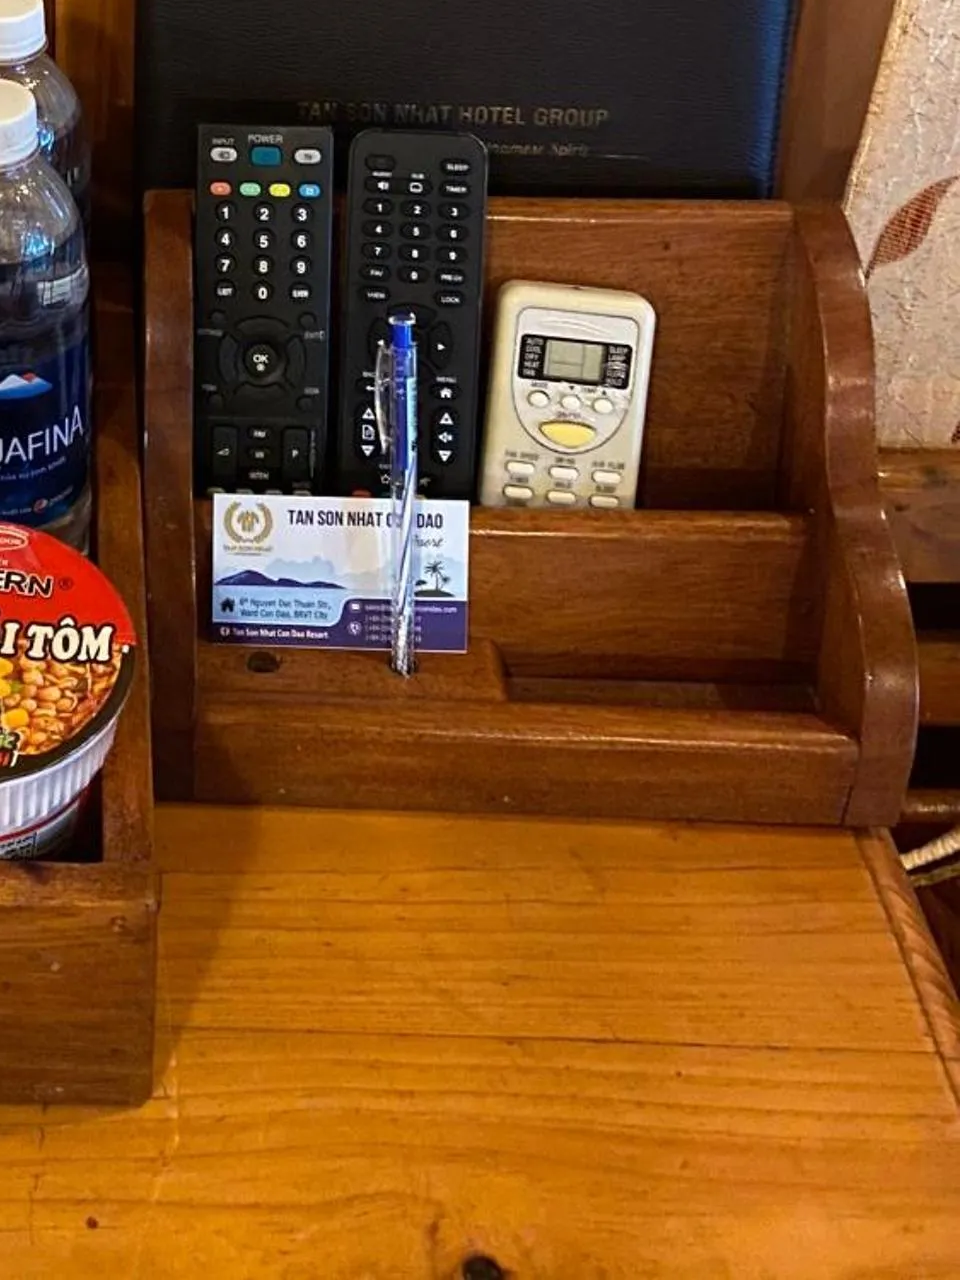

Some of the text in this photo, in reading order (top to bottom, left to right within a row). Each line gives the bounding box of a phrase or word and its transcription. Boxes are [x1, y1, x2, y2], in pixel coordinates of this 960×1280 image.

[394, 103, 453, 125] NHAT
[459, 106, 526, 125] HOTEL
[533, 107, 610, 127] GROUP
[247, 133, 284, 144] POWER
[221, 206, 229, 220] 1
[259, 207, 269, 221] 2
[297, 208, 308, 222] 3
[221, 233, 230, 246] 4
[259, 235, 269, 248] 5
[297, 235, 307, 248] 6
[221, 259, 230, 272] 7
[259, 260, 268, 273] 8
[297, 261, 306, 274] 9
[258, 287, 268, 300] 0
[252, 354, 269, 363] OK
[287, 509, 313, 526] TAN
[318, 510, 344, 526] SON
[347, 511, 384, 528] NHAT
[416, 513, 444, 529] DAO
[26, 617, 113, 662] TÔM
